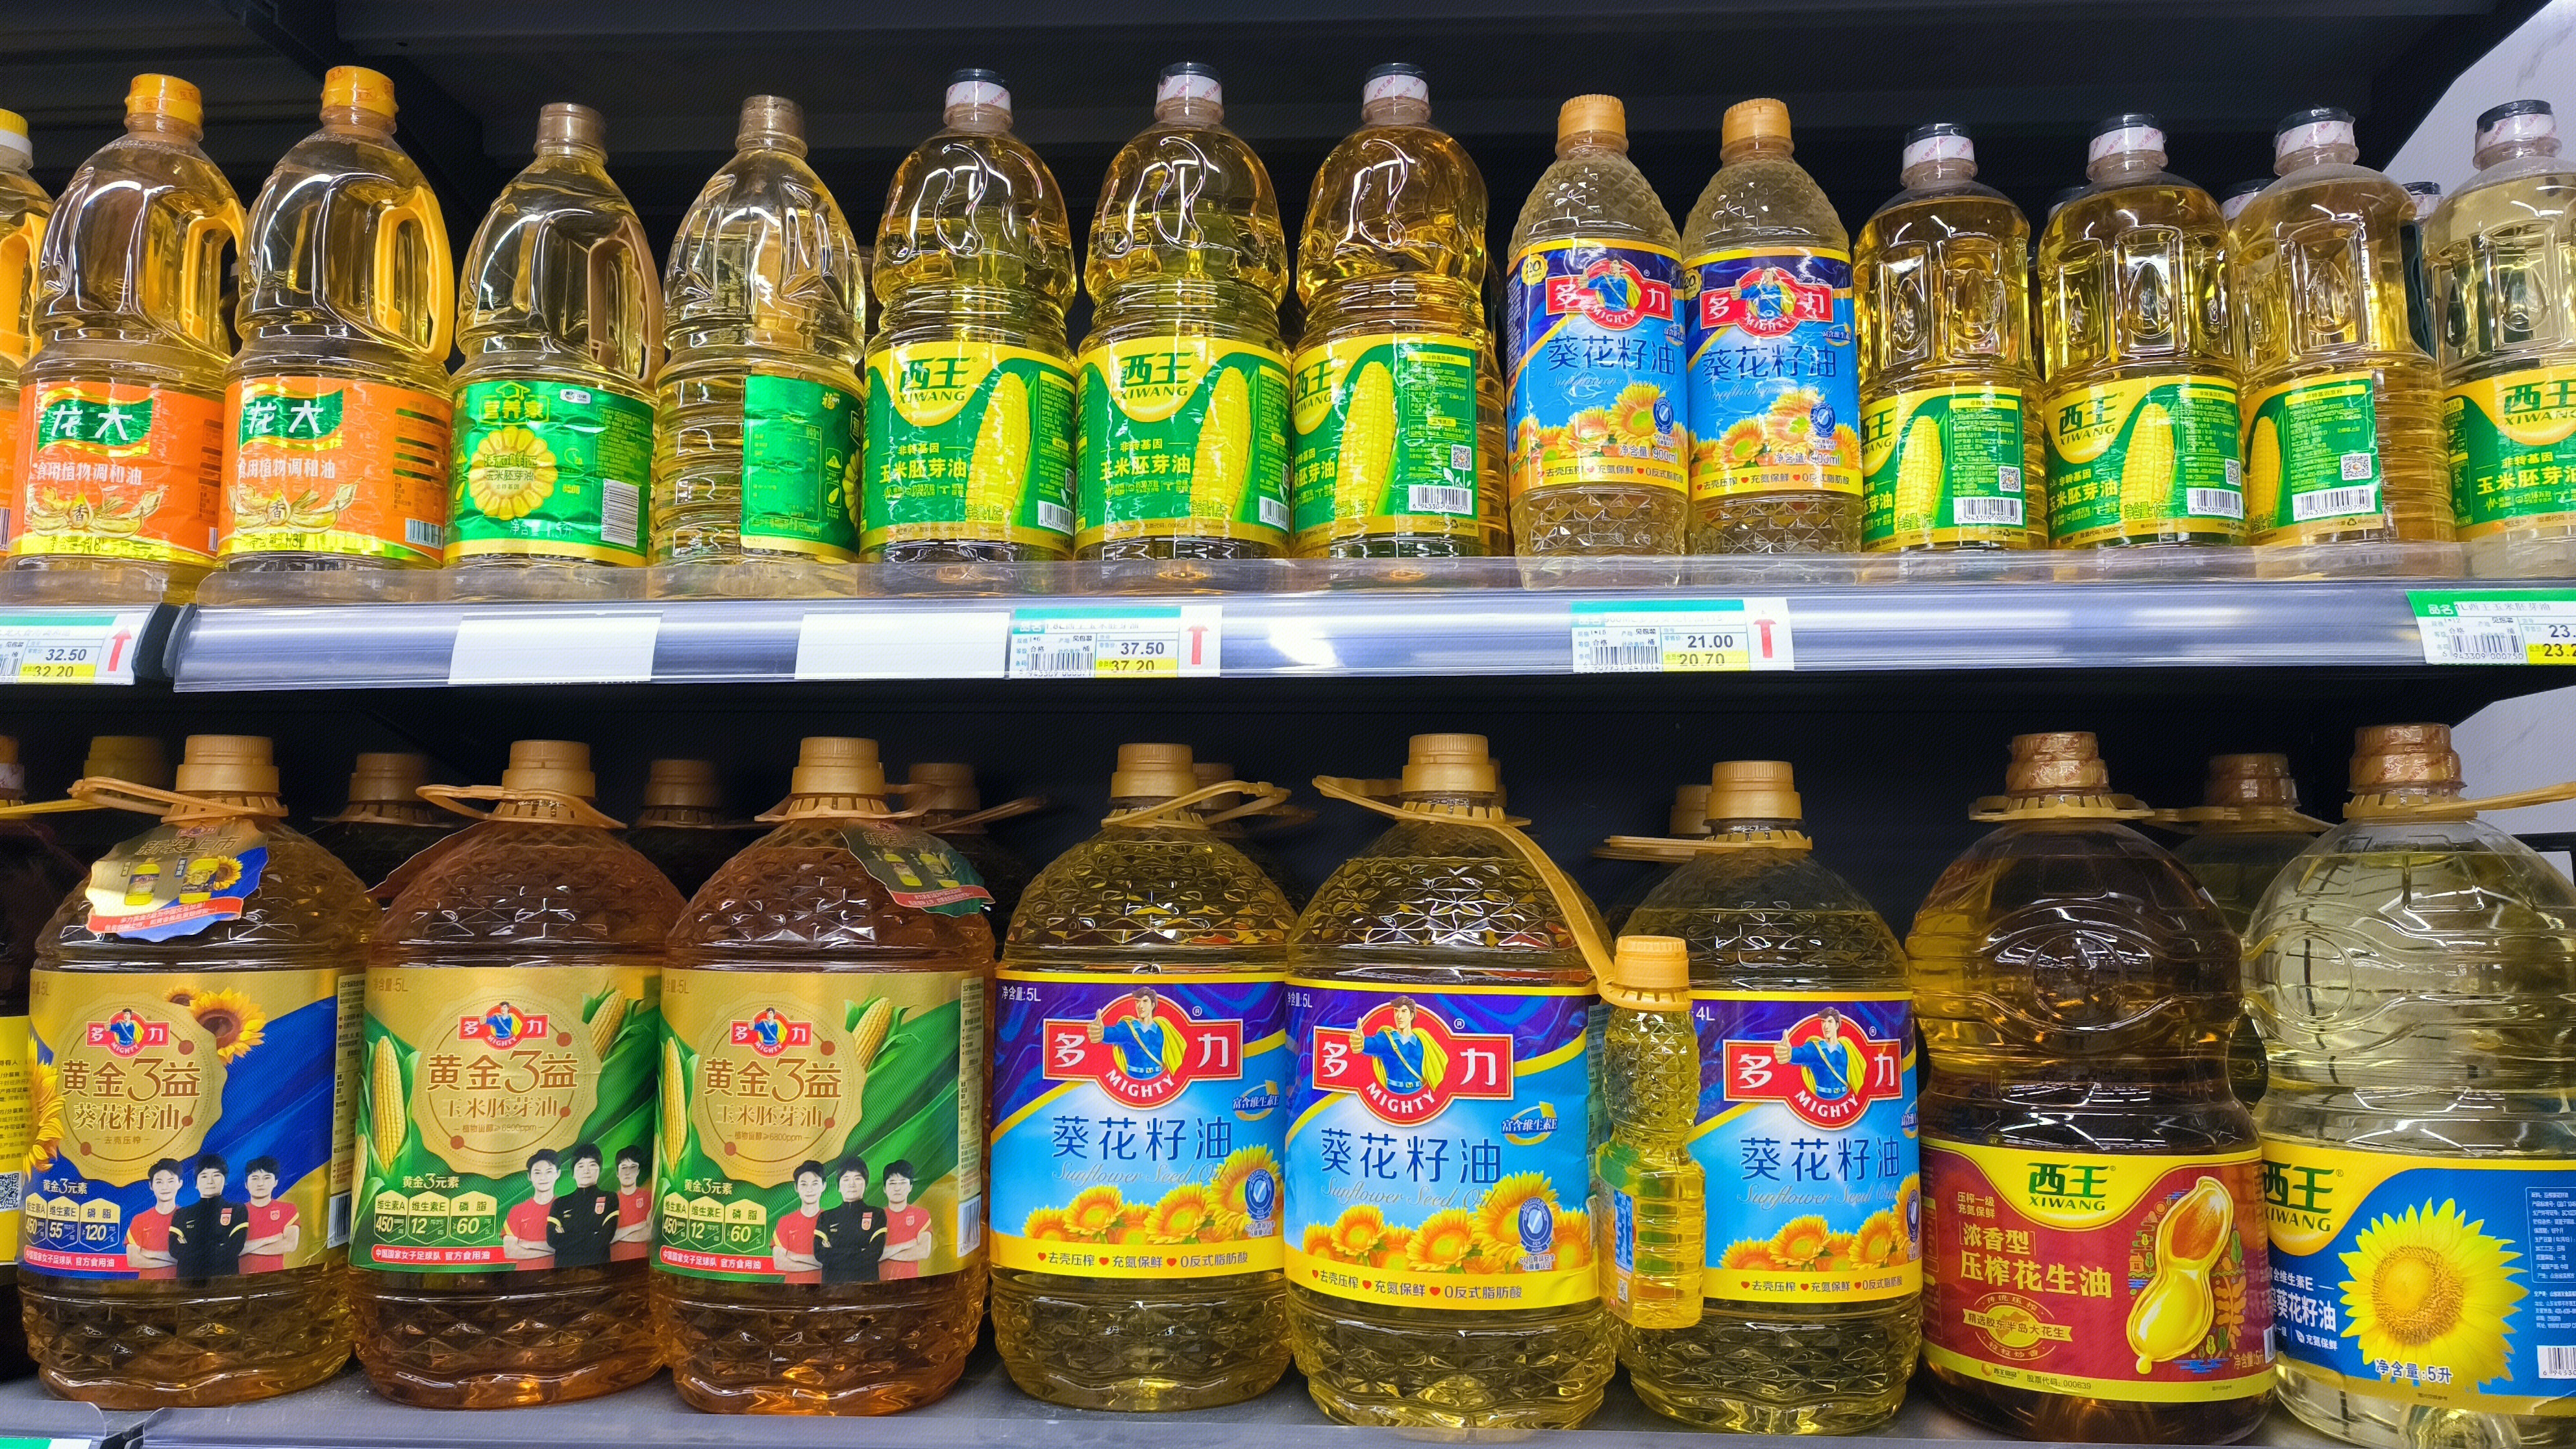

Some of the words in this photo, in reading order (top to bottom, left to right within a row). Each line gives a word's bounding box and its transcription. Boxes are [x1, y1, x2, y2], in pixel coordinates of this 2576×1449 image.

[1555, 284, 1578, 305] 多
[1648, 288, 1665, 311] 力
[1709, 295, 1729, 319] 多
[1799, 291, 1824, 315] 力
[1591, 307, 1636, 323] MIGHTY
[1743, 312, 1789, 331] MIGHTY
[1546, 335, 1676, 375] 葵花籽油
[899, 356, 970, 389] 西王
[1120, 354, 1193, 385] 西王
[1702, 345, 1836, 384] 葵花籽油
[1294, 358, 1333, 402] 西王
[898, 391, 965, 404] XIWANG
[1120, 386, 1189, 401] XIWANG
[2504, 380, 2576, 415] 西王
[2059, 393, 2118, 436] 西王
[2059, 424, 2116, 447] XIWANG
[1653, 448, 1677, 463] 900ml
[2501, 451, 2553, 469] 非转基因
[486, 470, 534, 480] 玉米胚芽油
[879, 458, 967, 484] 玉米胚芽油
[1100, 454, 1191, 481] 玉米胚芽油
[2477, 465, 2576, 495] 玉米胚芽油
[2048, 478, 2118, 514] 玉米胚芽油
[2428, 604, 2454, 615] 品名
[1121, 641, 1165, 655] 37.50
[1687, 634, 1733, 649] 21.00
[45, 649, 86, 661] 32.50
[1679, 653, 1725, 666] 20.70
[36, 666, 73, 677] 32.20
[1110, 660, 1154, 673] 37.20
[134, 836, 243, 856] 新装上市
[1002, 985, 1041, 1002] 净含量:5L
[1696, 1006, 1716, 1022] 4L
[90, 1027, 104, 1043] 多
[149, 1026, 165, 1041] 力
[463, 1020, 479, 1036] 多
[526, 1019, 543, 1034] 力
[734, 1024, 749, 1041] 多
[791, 1026, 806, 1043] 力
[110, 1041, 140, 1056] MIGHTY
[486, 1035, 517, 1046] MIGHTY
[755, 1040, 782, 1054] MIGHTY
[1054, 1032, 1085, 1068] 多
[1196, 1033, 1230, 1069] 力
[1322, 1041, 1348, 1079] 多
[1459, 1048, 1497, 1086] 力
[1737, 1053, 1773, 1090] 多
[1874, 1052, 1895, 1088] 力
[61, 1058, 202, 1102] 黄金3益
[427, 1050, 578, 1095] 黄金3益
[704, 1057, 842, 1103] 黄金3益
[1105, 1069, 1175, 1098] MIGHTY
[1365, 1080, 1437, 1115] MIGHTY
[1794, 1089, 1859, 1119] MIGHTY
[441, 1095, 558, 1119] 玉米胚芽油
[715, 1102, 823, 1129] 玉米胚芽油
[73, 1103, 182, 1132] 葵花籽油
[104, 1135, 142, 1146] 去壳压榨
[1052, 1115, 1232, 1162] 葵花籽油
[1320, 1128, 1502, 1184] 葵花籽油
[1740, 1137, 1900, 1182] 葵花籽油
[402, 1173, 460, 1189] 黄金3元素
[1053, 1161, 1144, 1189] Sunflower
[1152, 1163, 1191, 1184] Seed
[1197, 1161, 1226, 1183] Oil
[2027, 1162, 2111, 1200] 西王
[43, 1178, 88, 1195] 黄金3元素
[684, 1178, 733, 1195] 黄金3元素
[1321, 1176, 1404, 1206] Sunflower
[1407, 1185, 1457, 1207] Seed
[1462, 1187, 1495, 1209] Oil
[2263, 1159, 2334, 1214] 西王
[377, 1199, 405, 1211] 维生素A
[1737, 1183, 1831, 1211] Sunflower
[1835, 1185, 1872, 1206] Seed
[1876, 1182, 1899, 1202] Oil
[1957, 1191, 1995, 1207] 压榨一级
[2029, 1196, 2106, 1212] XIWANG
[49, 1206, 77, 1217] 维生素E
[88, 1208, 112, 1219] 磷脂
[412, 1202, 446, 1212] 维生素E
[459, 1201, 487, 1212] 磷脂
[691, 1205, 721, 1218] 维生素E
[732, 1209, 758, 1220] 磷脂
[1957, 1203, 1996, 1219] 充氮保鲜
[27, 1218, 38, 1235] 450
[49, 1222, 64, 1238] 55
[85, 1224, 106, 1241] 120
[376, 1216, 393, 1233] 450
[412, 1218, 427, 1234] 12
[457, 1217, 479, 1234] 60
[663, 1217, 677, 1234] 450
[691, 1222, 705, 1239] 12
[730, 1226, 751, 1242] 60
[1963, 1222, 2029, 1256] 浓香型
[376, 1248, 441, 1260] 中国国家女子足球队
[445, 1251, 490, 1261] 官方食用油
[1048, 1251, 1095, 1267] 去壳压榨
[1112, 1255, 1163, 1269] 充氮保鲜
[1180, 1250, 1248, 1269] 0反式脂肪酸
[1960, 1252, 2112, 1298] 压榨花生油
[1320, 1269, 1359, 1289] 去壳压榨
[1374, 1279, 1426, 1297] 充氮保鲜
[1444, 1285, 1523, 1300] 0反式脂肪酸
[1751, 1280, 1796, 1293] 去壳压榨
[1811, 1282, 1851, 1293] 充氮保鲜
[1968, 1313, 2065, 1338] 精选胶东半岛大花生
[2305, 1334, 2338, 1350] 充氮保鲜
[2375, 1359, 2453, 1385] 净含量:5升
[2063, 1380, 2091, 1390] 000639
